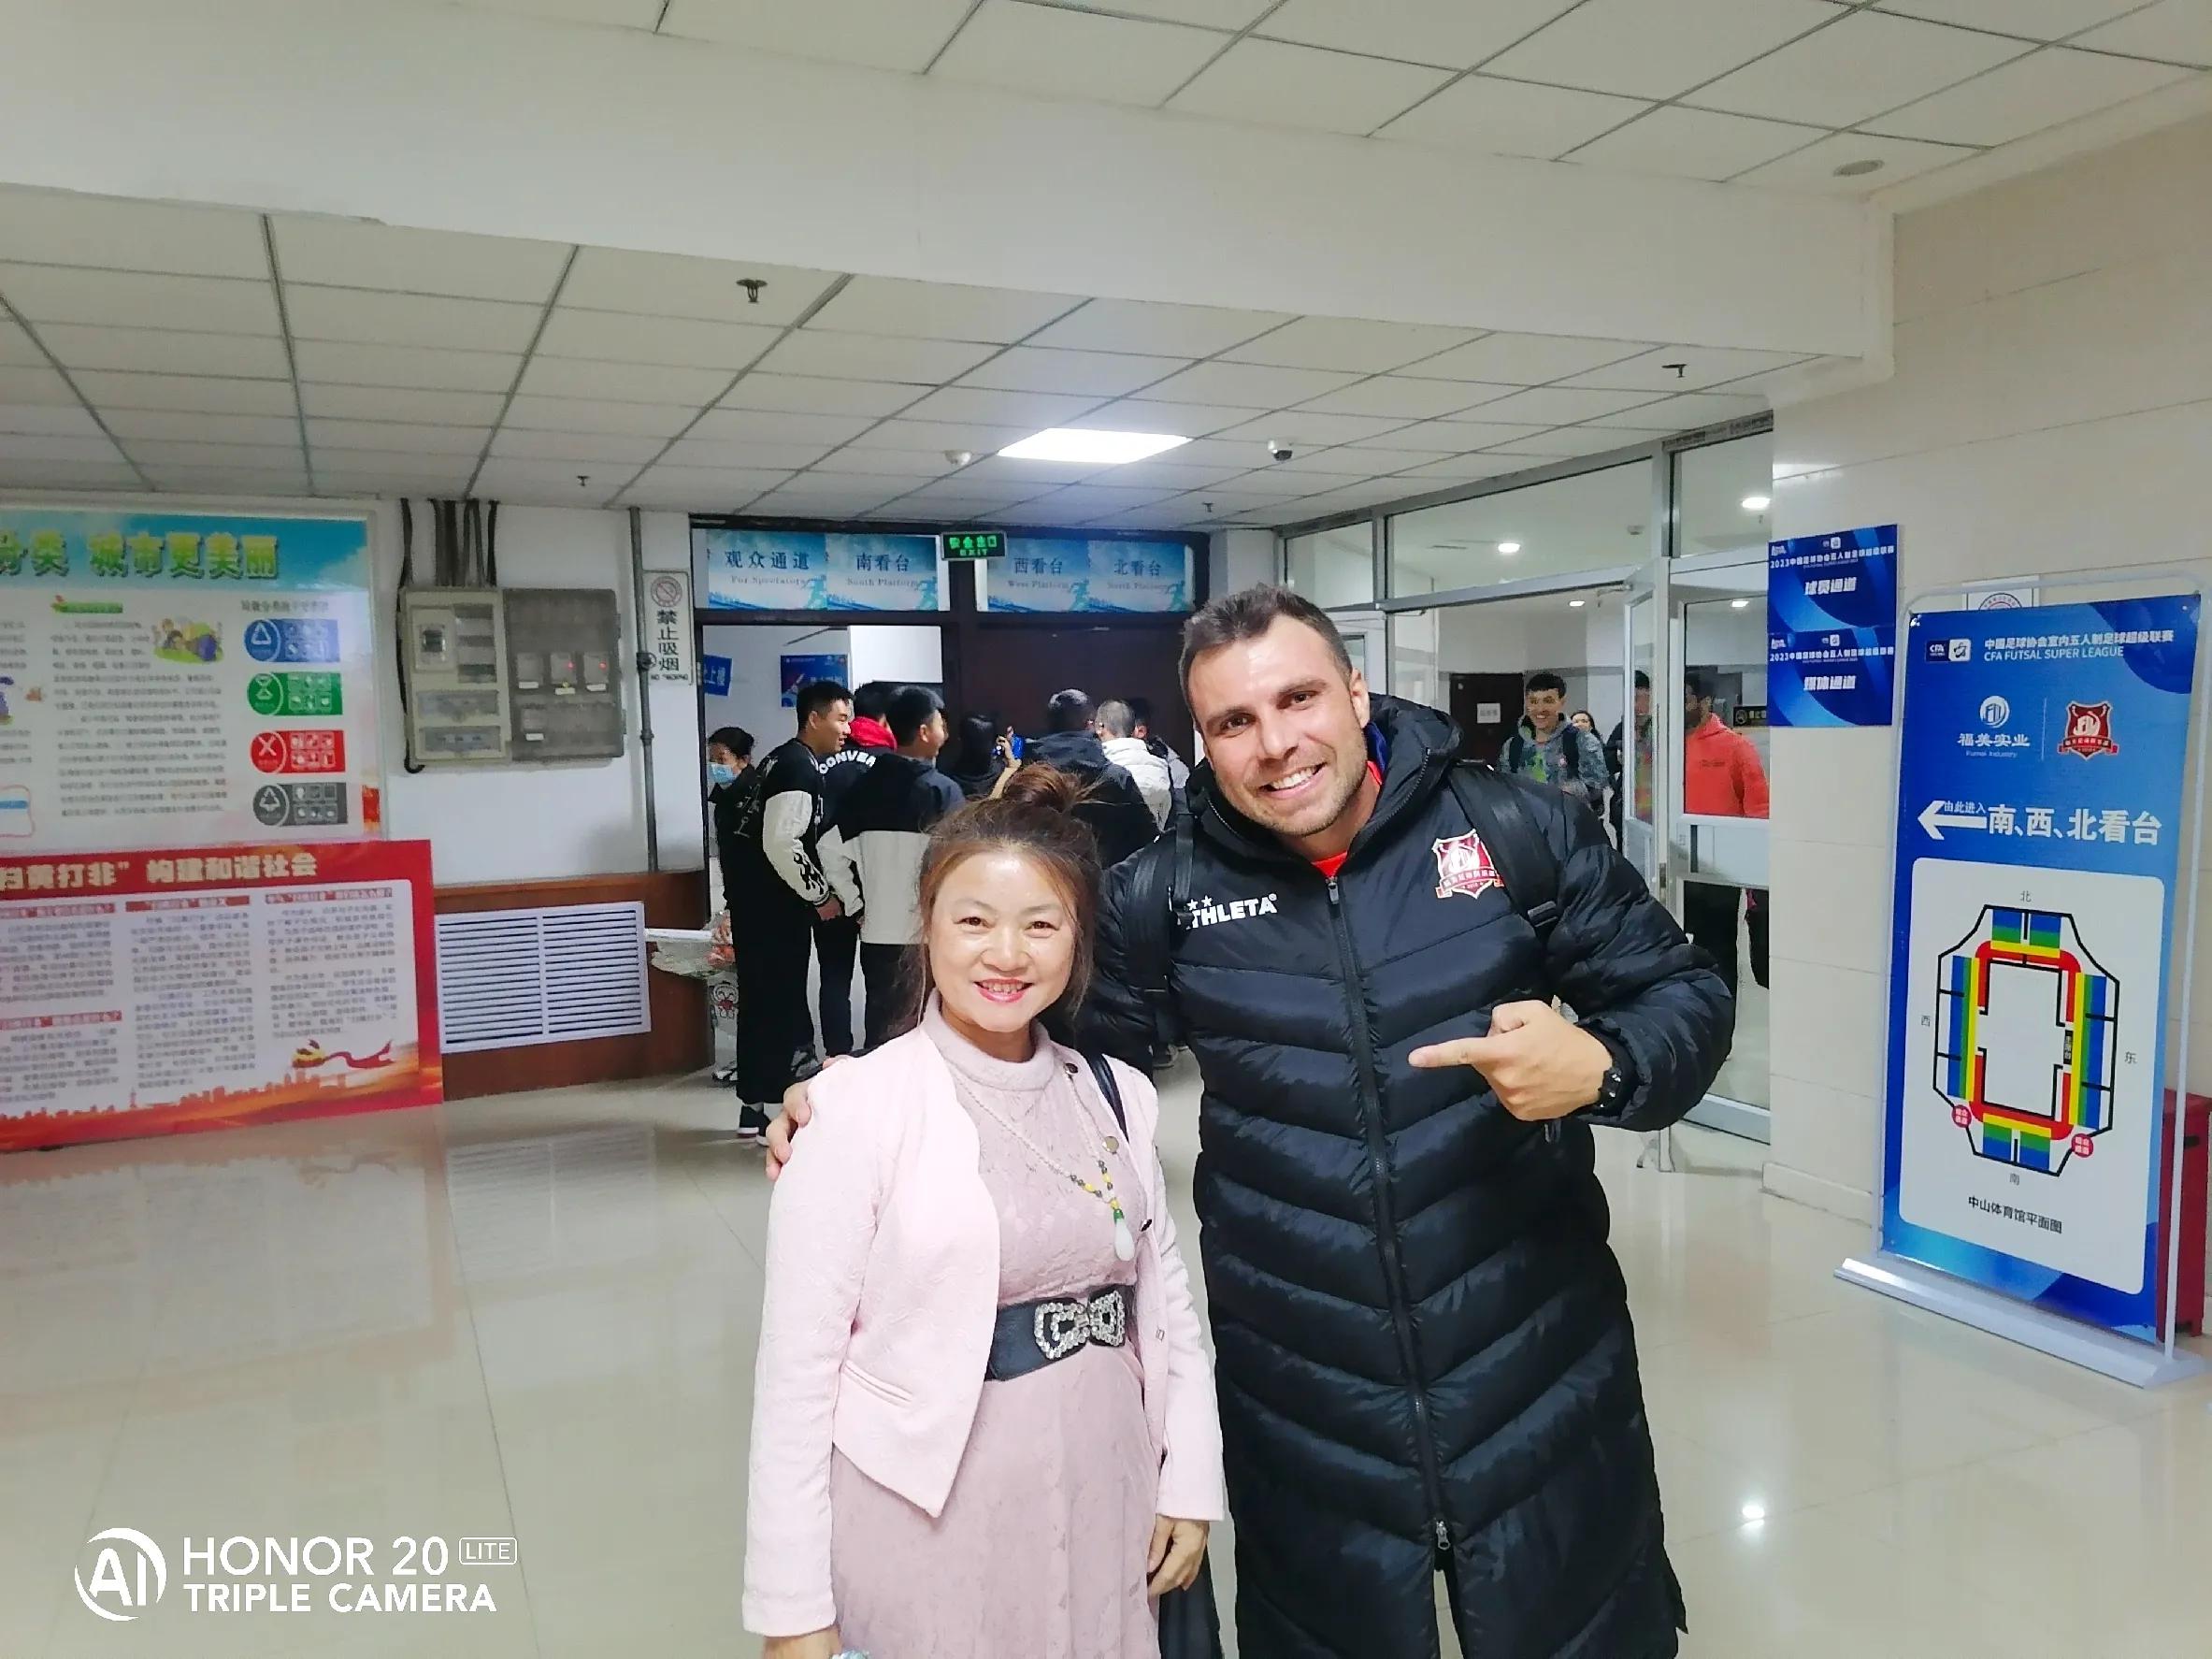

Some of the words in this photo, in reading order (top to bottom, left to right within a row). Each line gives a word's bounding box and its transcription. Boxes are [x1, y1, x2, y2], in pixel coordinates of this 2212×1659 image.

[725, 550, 811, 570] 观众通道
[855, 553, 910, 572] 南看台
[1013, 556, 1064, 575] 西看台
[1113, 558, 1162, 577] 北看台
[657, 610, 679, 671] 禁止吸烟
[1984, 651, 2003, 662] CFA
[2004, 649, 2043, 660] FUTSAL
[2044, 648, 2080, 659] SUPER
[2082, 646, 2125, 658] LEAGUE
[1957, 733, 2031, 747] 福美实业
[1944, 801, 1987, 815] 由此进入
[1988, 803, 2162, 845] 南、西、北看台
[2019, 890, 2032, 902] 北
[1186, 896, 1278, 930] THLETA
[2124, 1051, 2137, 1064] 东
[1968, 1195, 2062, 1234] 中山体育馆平面图
